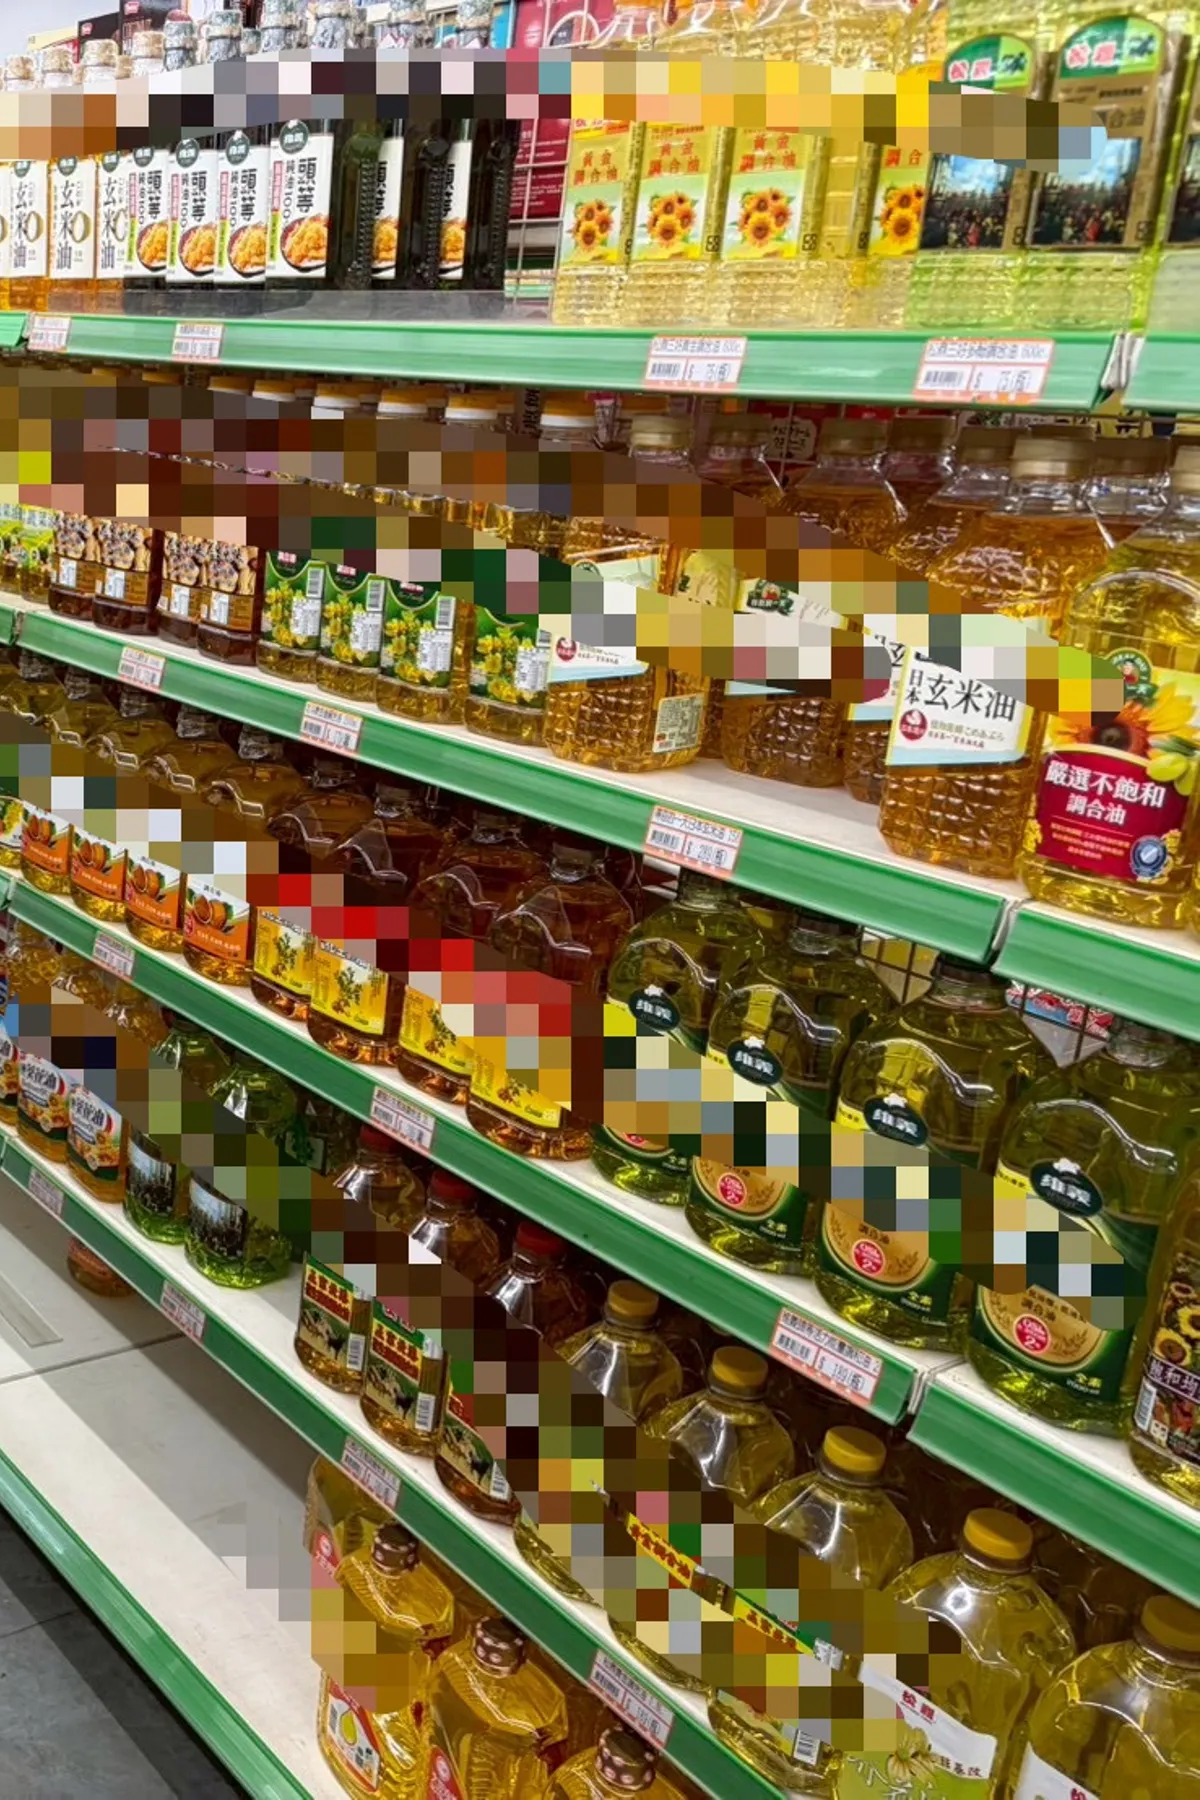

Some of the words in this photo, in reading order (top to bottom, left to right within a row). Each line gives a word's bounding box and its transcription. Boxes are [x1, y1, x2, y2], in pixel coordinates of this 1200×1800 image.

[14, 182, 27, 269] 玄米油
[57, 180, 74, 270] 玄米油
[101, 177, 117, 269] 玄米油
[905, 669, 924, 705] 日本
[925, 671, 1017, 722] 玄米油
[1045, 760, 1167, 809] 嚴選不飽和
[1066, 793, 1128, 827] 調合油
